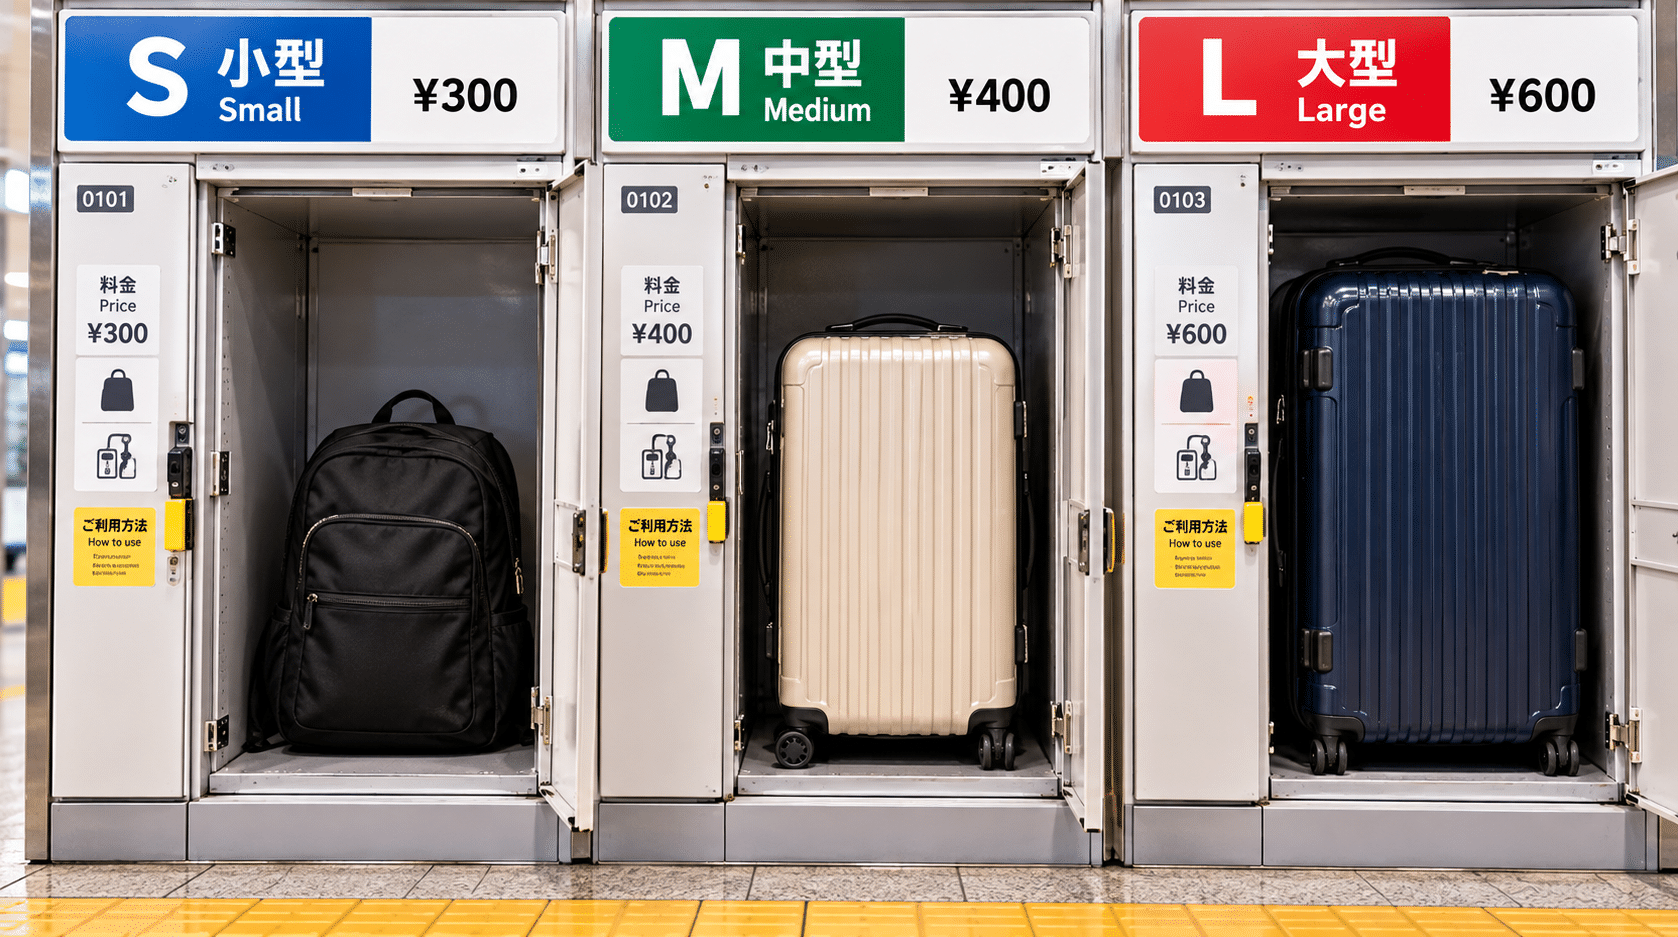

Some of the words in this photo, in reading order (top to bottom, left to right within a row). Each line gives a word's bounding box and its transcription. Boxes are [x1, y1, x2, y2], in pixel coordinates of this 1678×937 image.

[218, 38, 324, 87] 小型
[765, 39, 861, 88] 中型
[1298, 39, 1397, 87] 大型
[127, 36, 188, 116] S
[662, 39, 739, 116] M
[1203, 39, 1256, 115] L
[413, 78, 517, 112] ¥300
[949, 78, 1050, 112] ¥400
[1490, 78, 1595, 112] ¥600
[219, 97, 301, 121] Small
[765, 97, 870, 121] Medium
[1299, 98, 1385, 128] Large
[83, 191, 125, 207] 0101
[627, 192, 672, 208] 0102
[1160, 192, 1205, 208] 0103
[100, 276, 136, 294] 料金
[645, 276, 680, 294] 料金
[1179, 277, 1214, 294] 料金
[101, 299, 136, 312] Price
[645, 300, 680, 312] Price
[1179, 300, 1214, 312] Price
[88, 323, 148, 343] ¥300
[632, 323, 692, 344] ¥400
[1166, 324, 1226, 344] ¥600
[82, 518, 148, 533] ご利用方法
[628, 518, 693, 533] ご利用方法
[1163, 519, 1228, 534] ご利用方法
[88, 537, 110, 547] How
[111, 538, 122, 547] to
[124, 539, 142, 547] use
[634, 537, 656, 548] How
[657, 538, 668, 548] to
[669, 539, 687, 548] use
[1169, 538, 1191, 548] How
[1192, 539, 1203, 548] to
[1204, 540, 1222, 548] use
